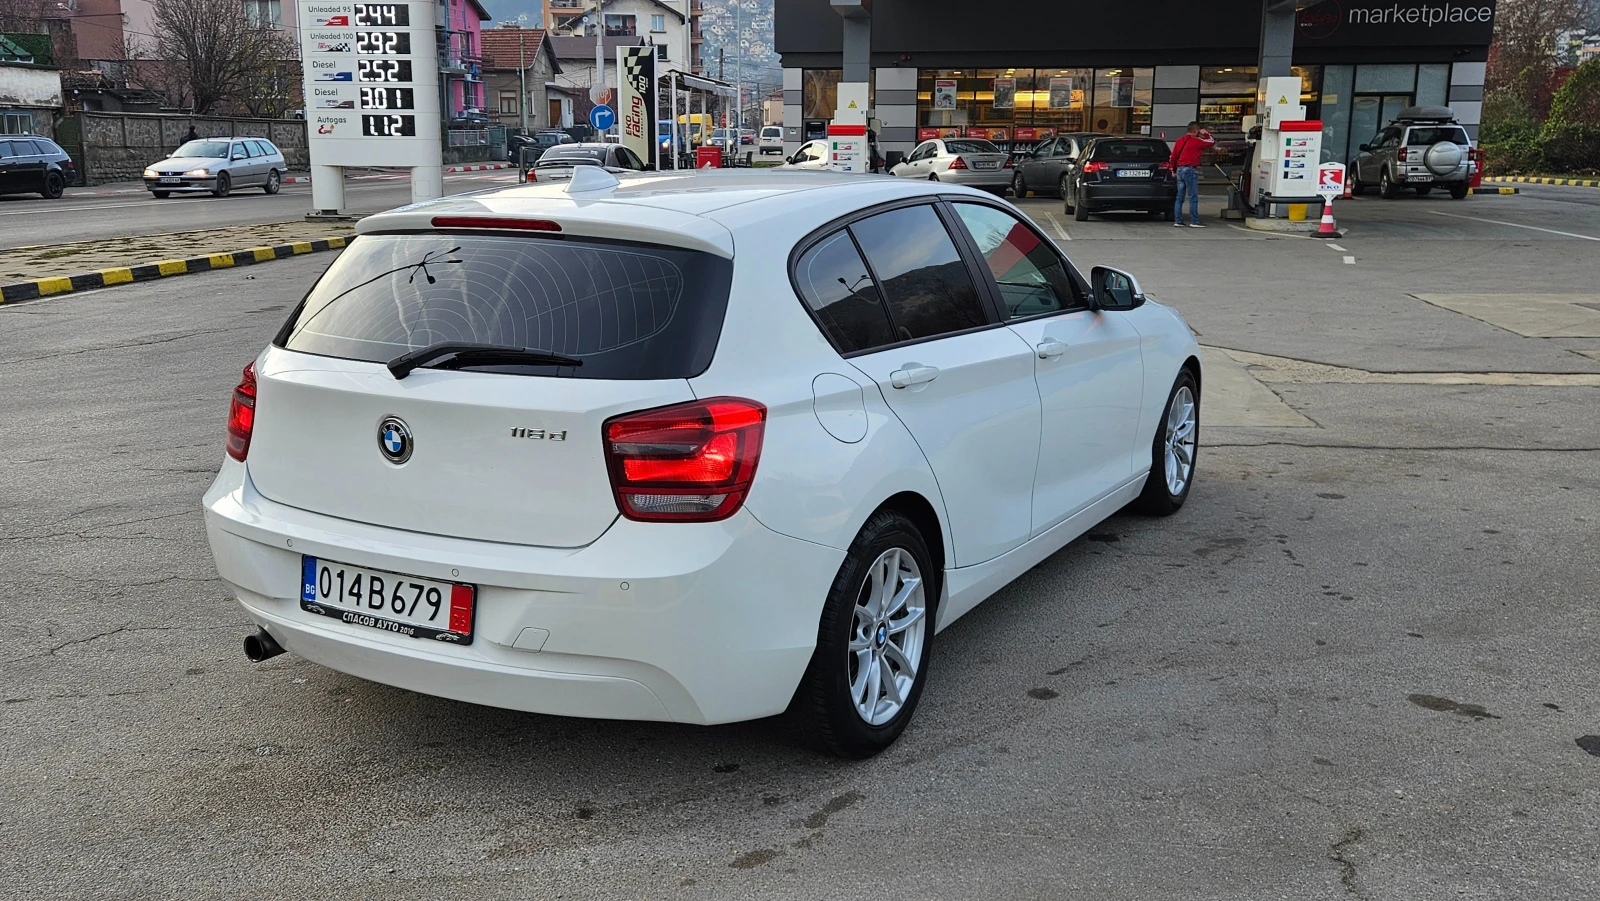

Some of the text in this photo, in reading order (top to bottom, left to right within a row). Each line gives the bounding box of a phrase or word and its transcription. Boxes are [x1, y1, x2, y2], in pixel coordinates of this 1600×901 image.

[355, 4, 396, 26] 2.44
[1349, 3, 1492, 27] marketplace
[357, 32, 398, 54] 2.92
[312, 60, 336, 68] Diesel
[359, 60, 399, 82] 2.52
[314, 88, 338, 96] Diesel
[638, 75, 646, 94] 100
[361, 87, 402, 109] 3.01
[317, 116, 347, 125] Autogas
[369, 115, 402, 136] 1.12
[631, 95, 642, 138] racing
[305, 583, 316, 595] BG
[319, 566, 442, 621] 014B679
[342, 611, 415, 636] СПАСОВ АУТО 2016
